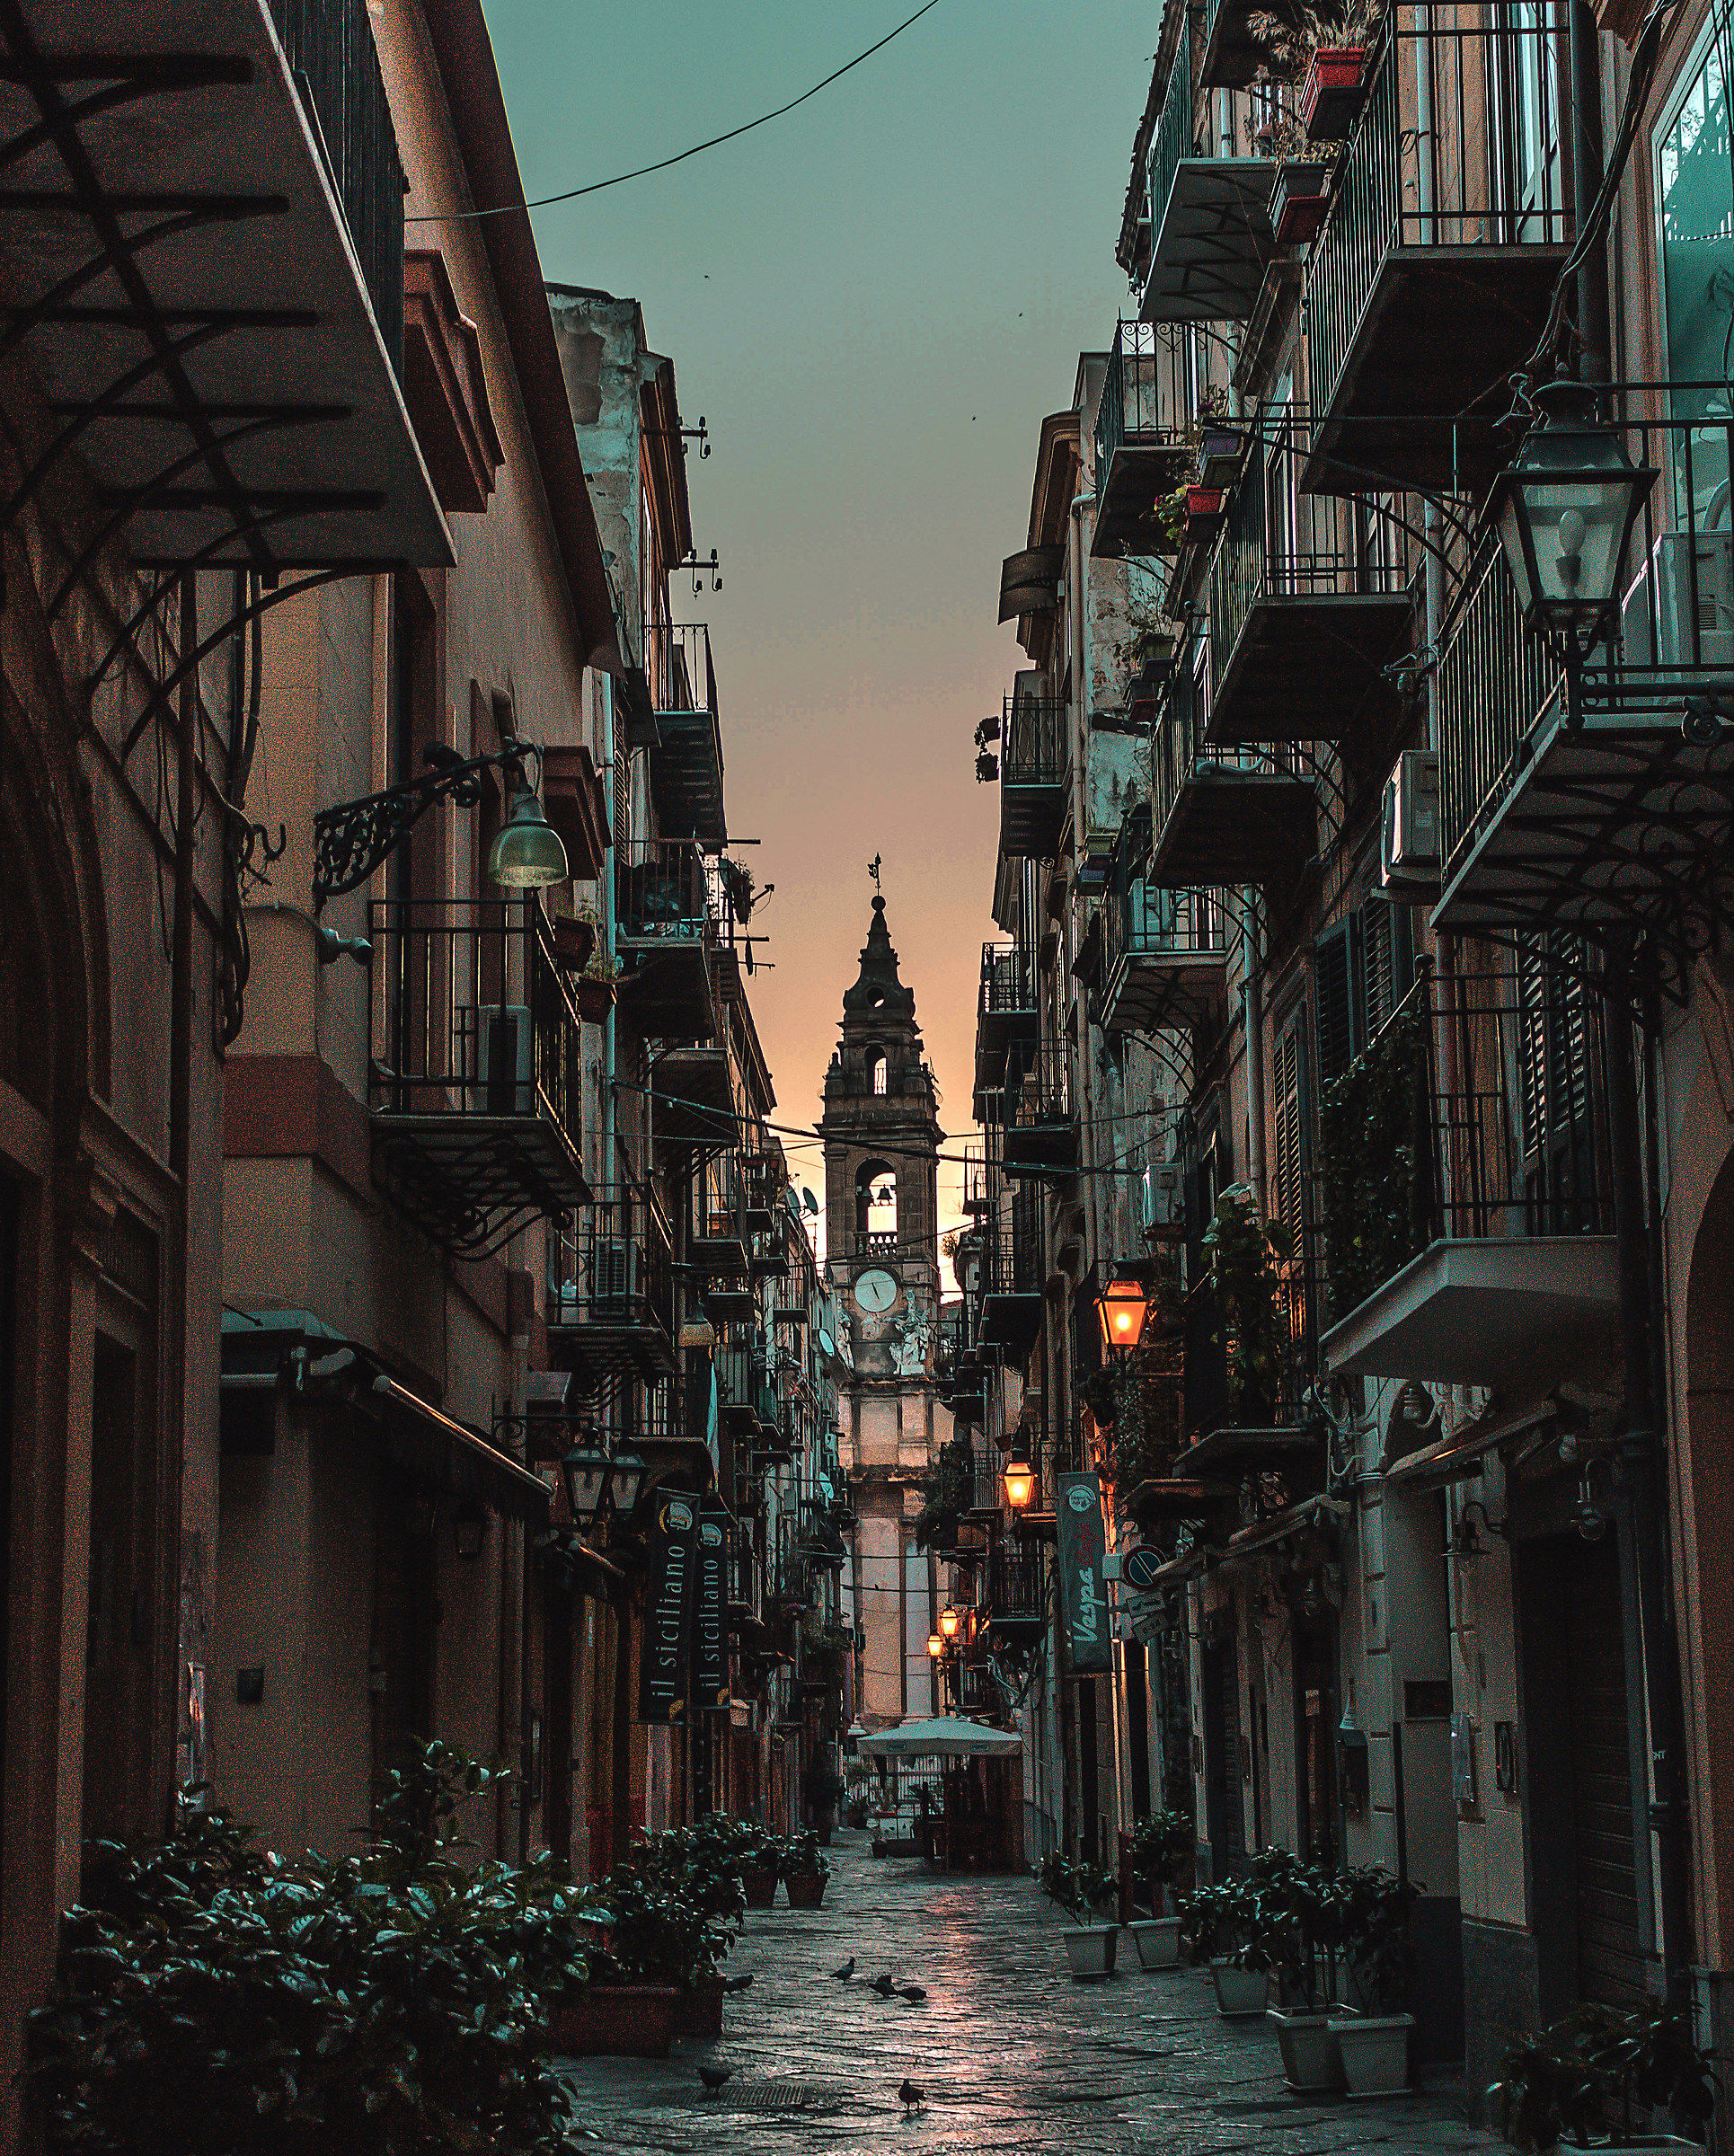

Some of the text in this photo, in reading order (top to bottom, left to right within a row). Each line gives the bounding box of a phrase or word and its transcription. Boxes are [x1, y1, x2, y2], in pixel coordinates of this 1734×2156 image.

[650, 1545, 686, 1697] il siciliano
[699, 1560, 720, 1687] il siciliano
[1073, 1567, 1106, 1642] Vespa
